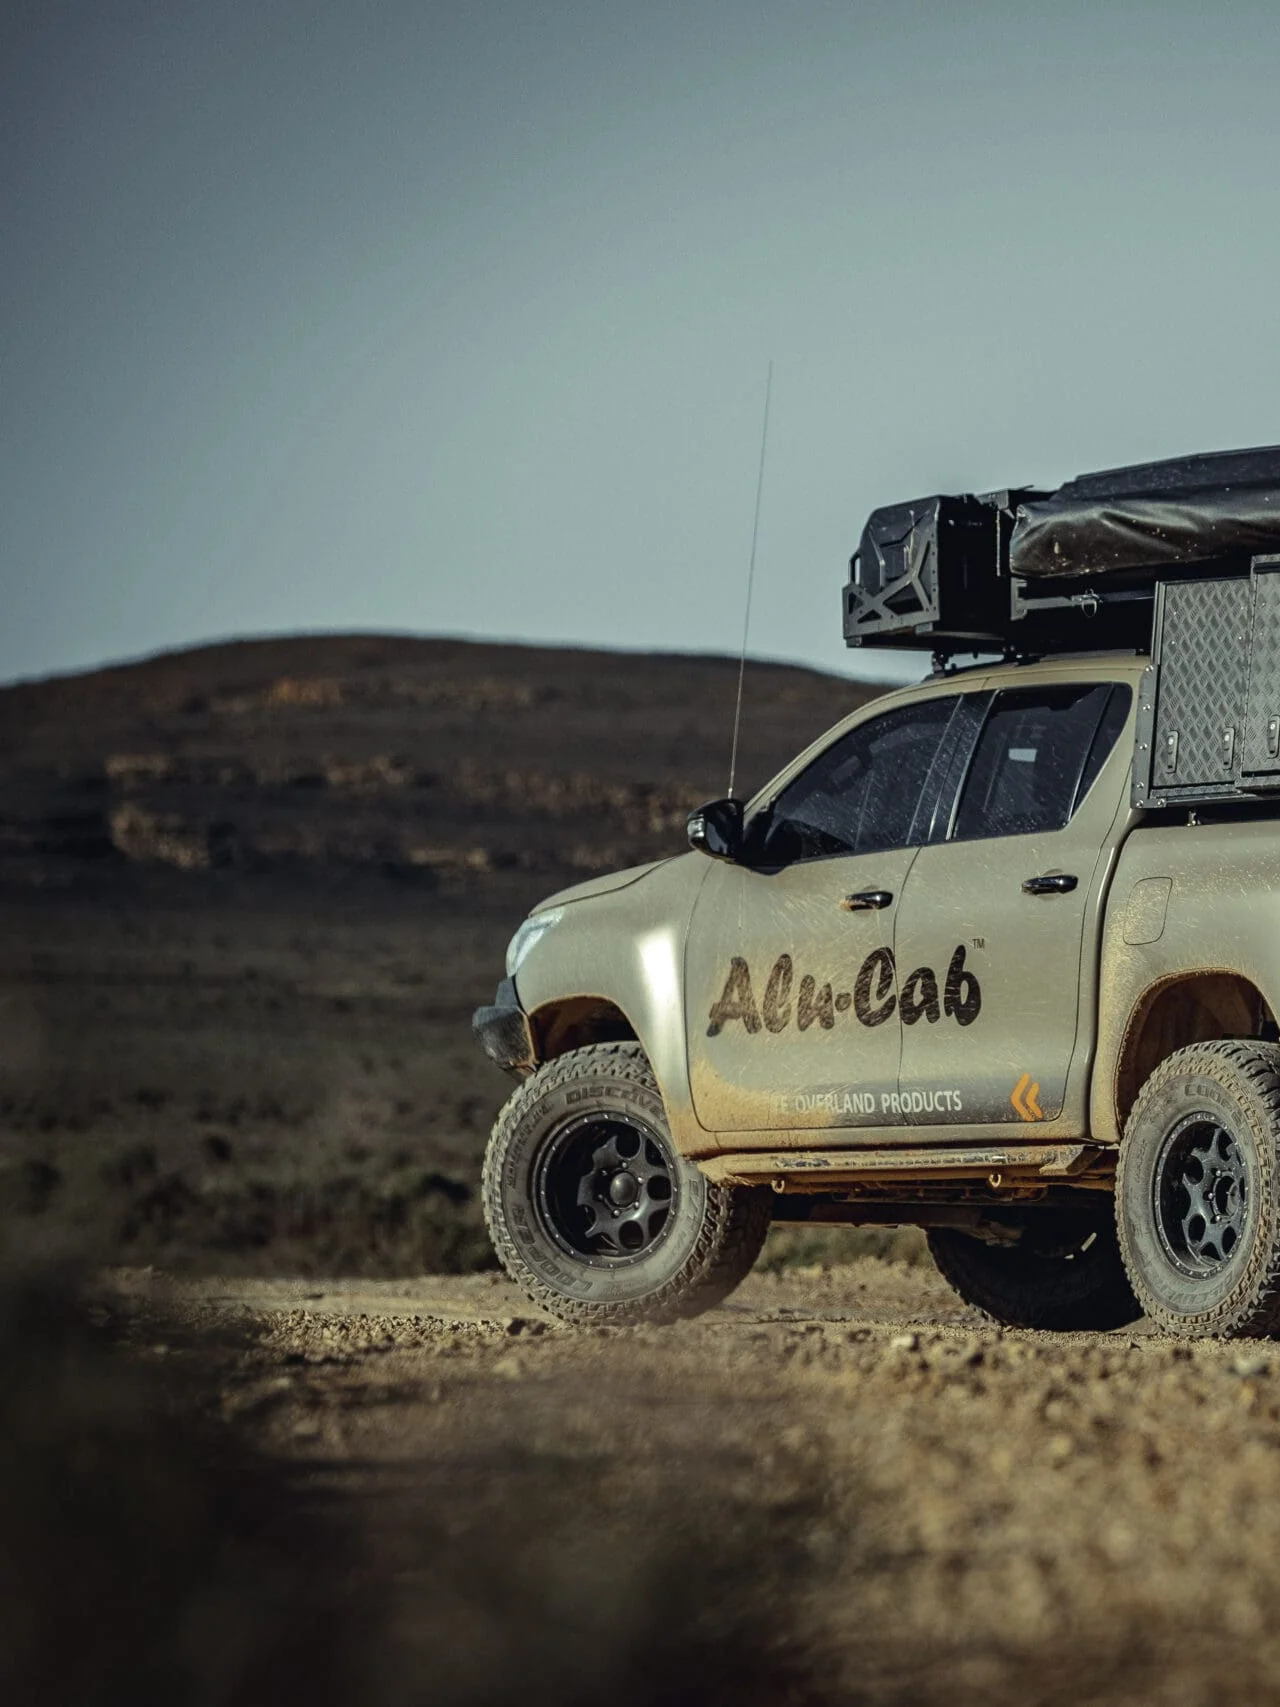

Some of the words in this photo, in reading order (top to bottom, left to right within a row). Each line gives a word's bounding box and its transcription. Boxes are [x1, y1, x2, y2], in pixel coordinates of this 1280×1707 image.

[706, 944, 982, 1037] Alu-Cab
[795, 1092, 876, 1115] OVERLAND
[882, 1090, 962, 1114] PRODUCTS
